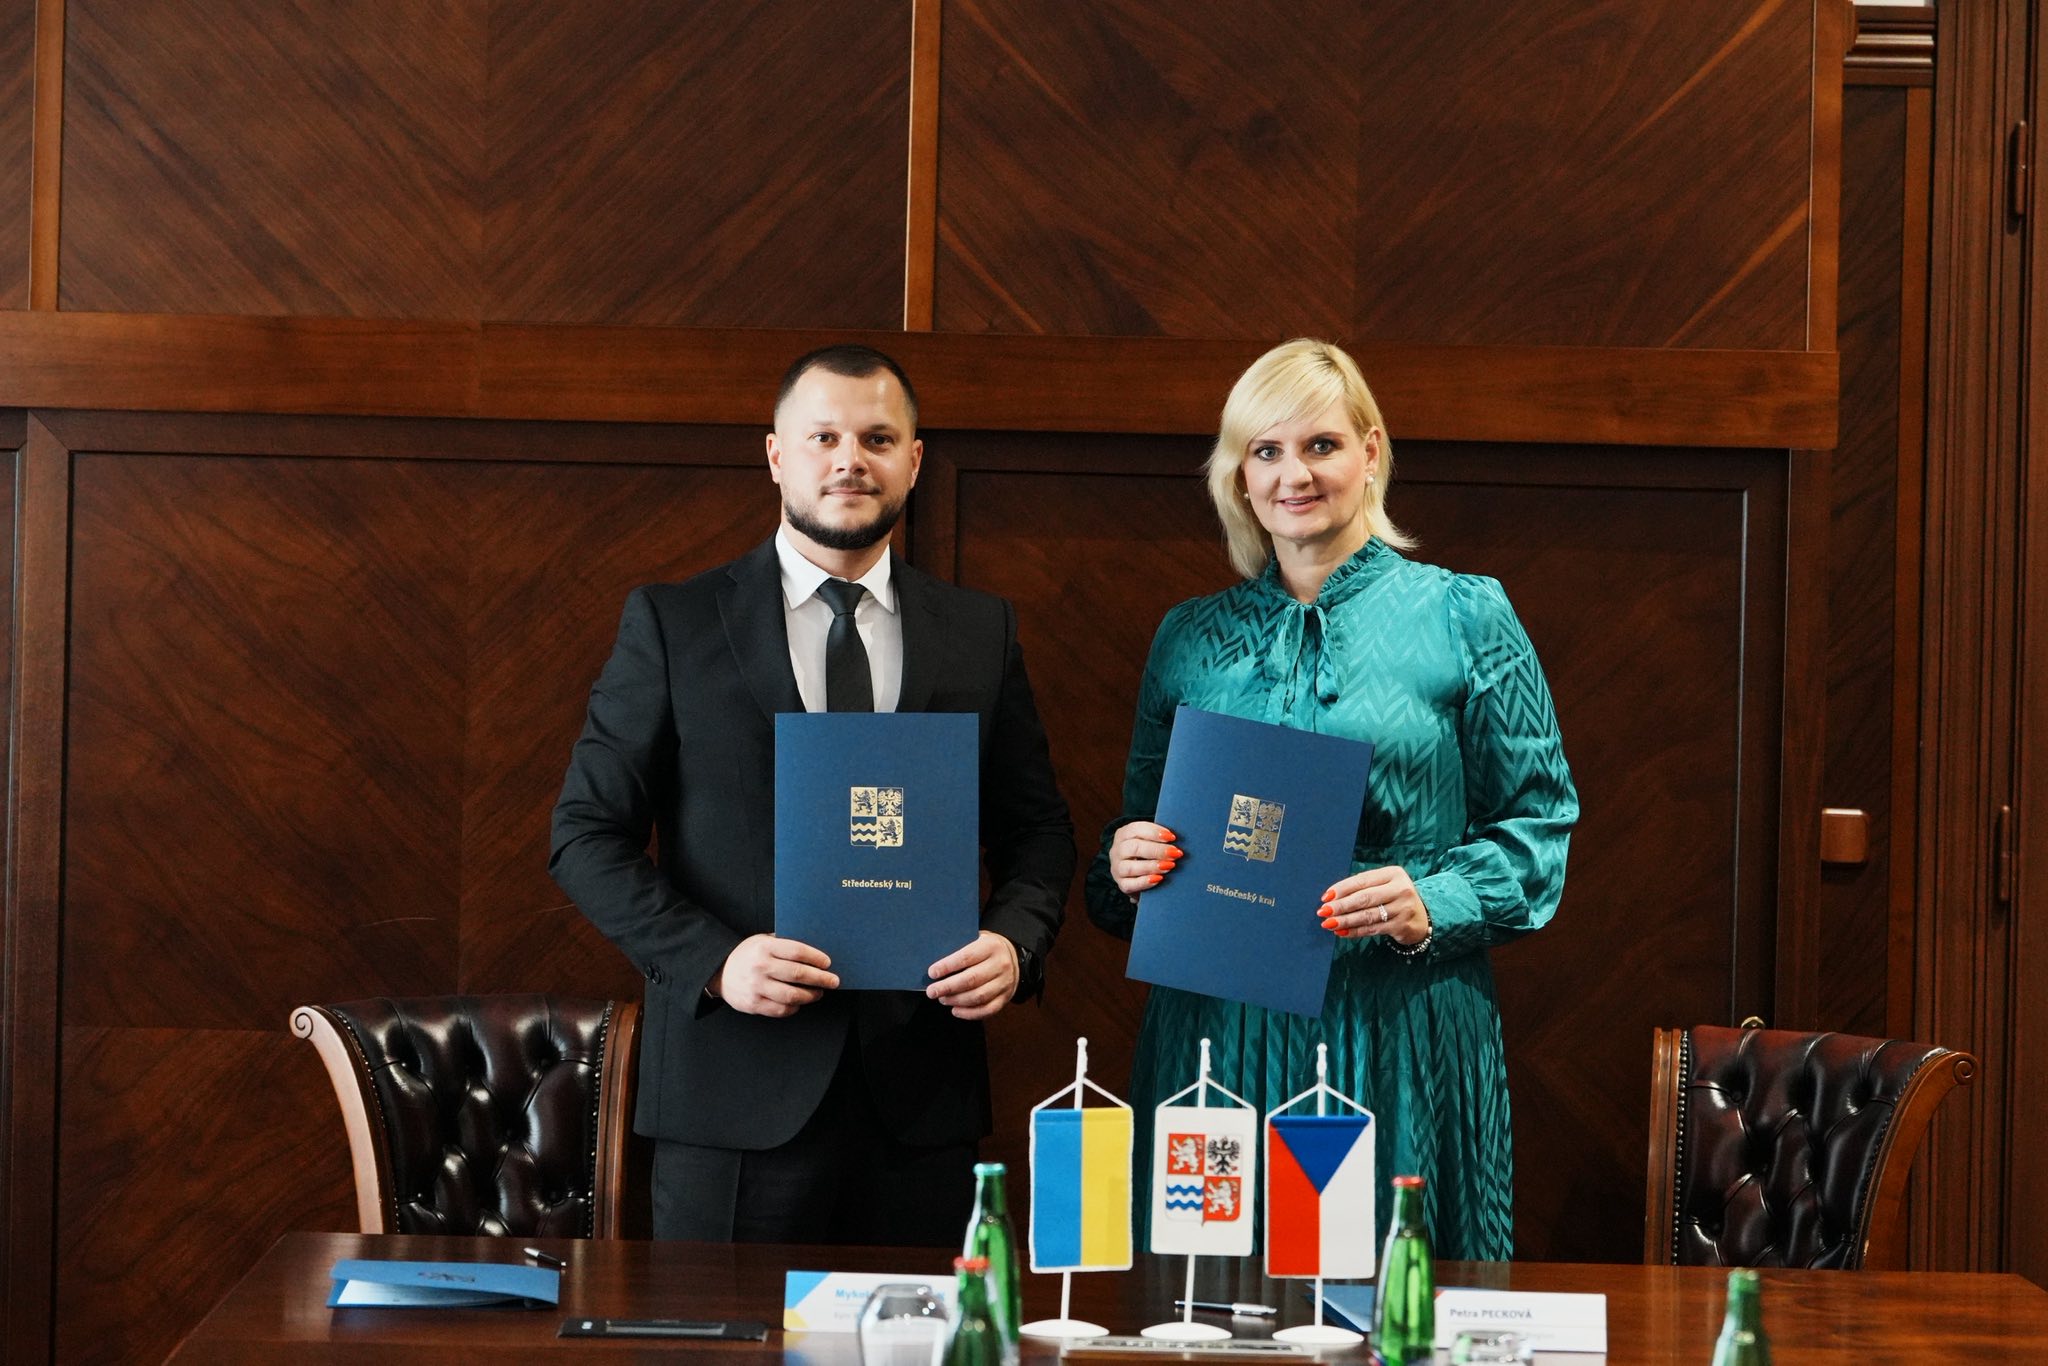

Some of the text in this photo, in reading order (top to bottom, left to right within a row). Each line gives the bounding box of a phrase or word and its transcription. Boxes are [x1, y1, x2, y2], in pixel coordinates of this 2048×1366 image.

[841, 879, 912, 890] Středočeský kraj
[1206, 884, 1276, 907] Středočeský kraj
[1449, 1308, 1532, 1319] Petra PECKOVÁ
